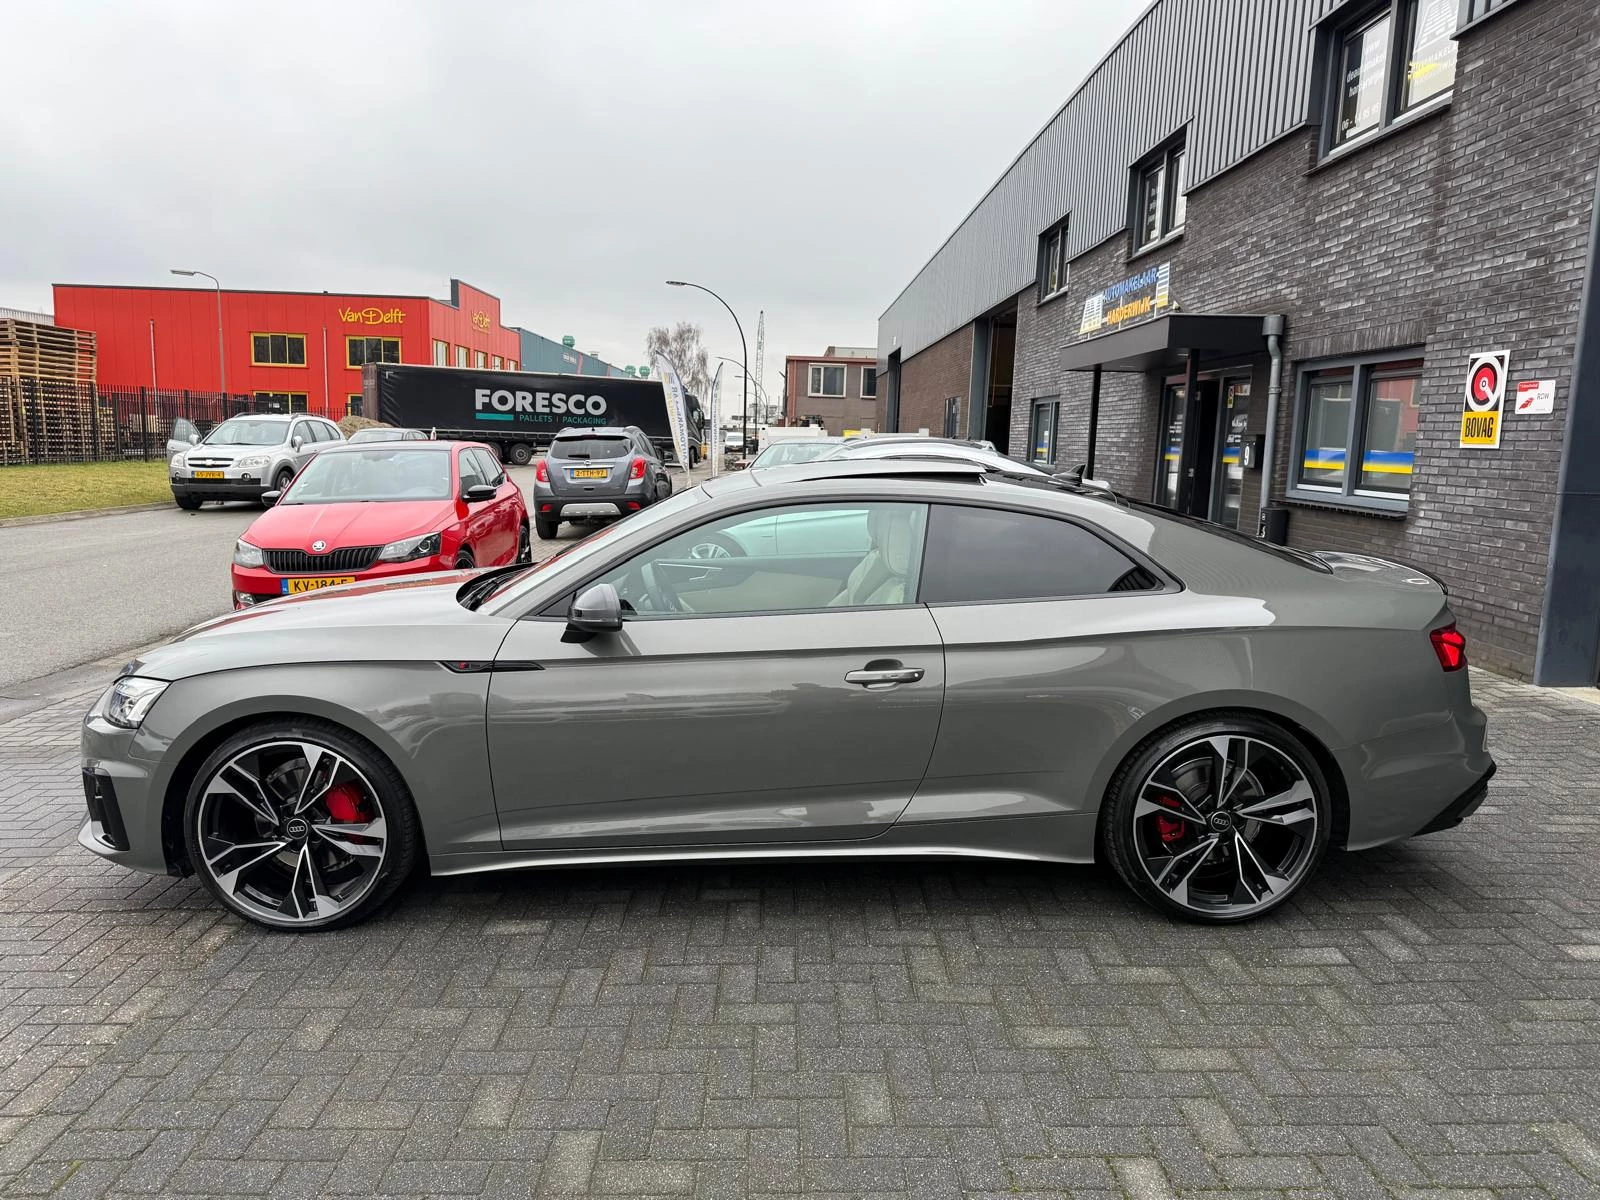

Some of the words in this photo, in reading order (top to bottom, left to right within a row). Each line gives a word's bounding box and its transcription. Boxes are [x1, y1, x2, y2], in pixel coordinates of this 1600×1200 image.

[1103, 267, 1157, 302] AUTOMAKELAAR
[1107, 296, 1151, 326] HARDERWIJK
[475, 388, 607, 416] FORESCO
[519, 414, 553, 423] PALLETS
[562, 416, 607, 425] PACKAGING
[1464, 417, 1494, 438] BOVAG
[1244, 446, 1250, 466] 9
